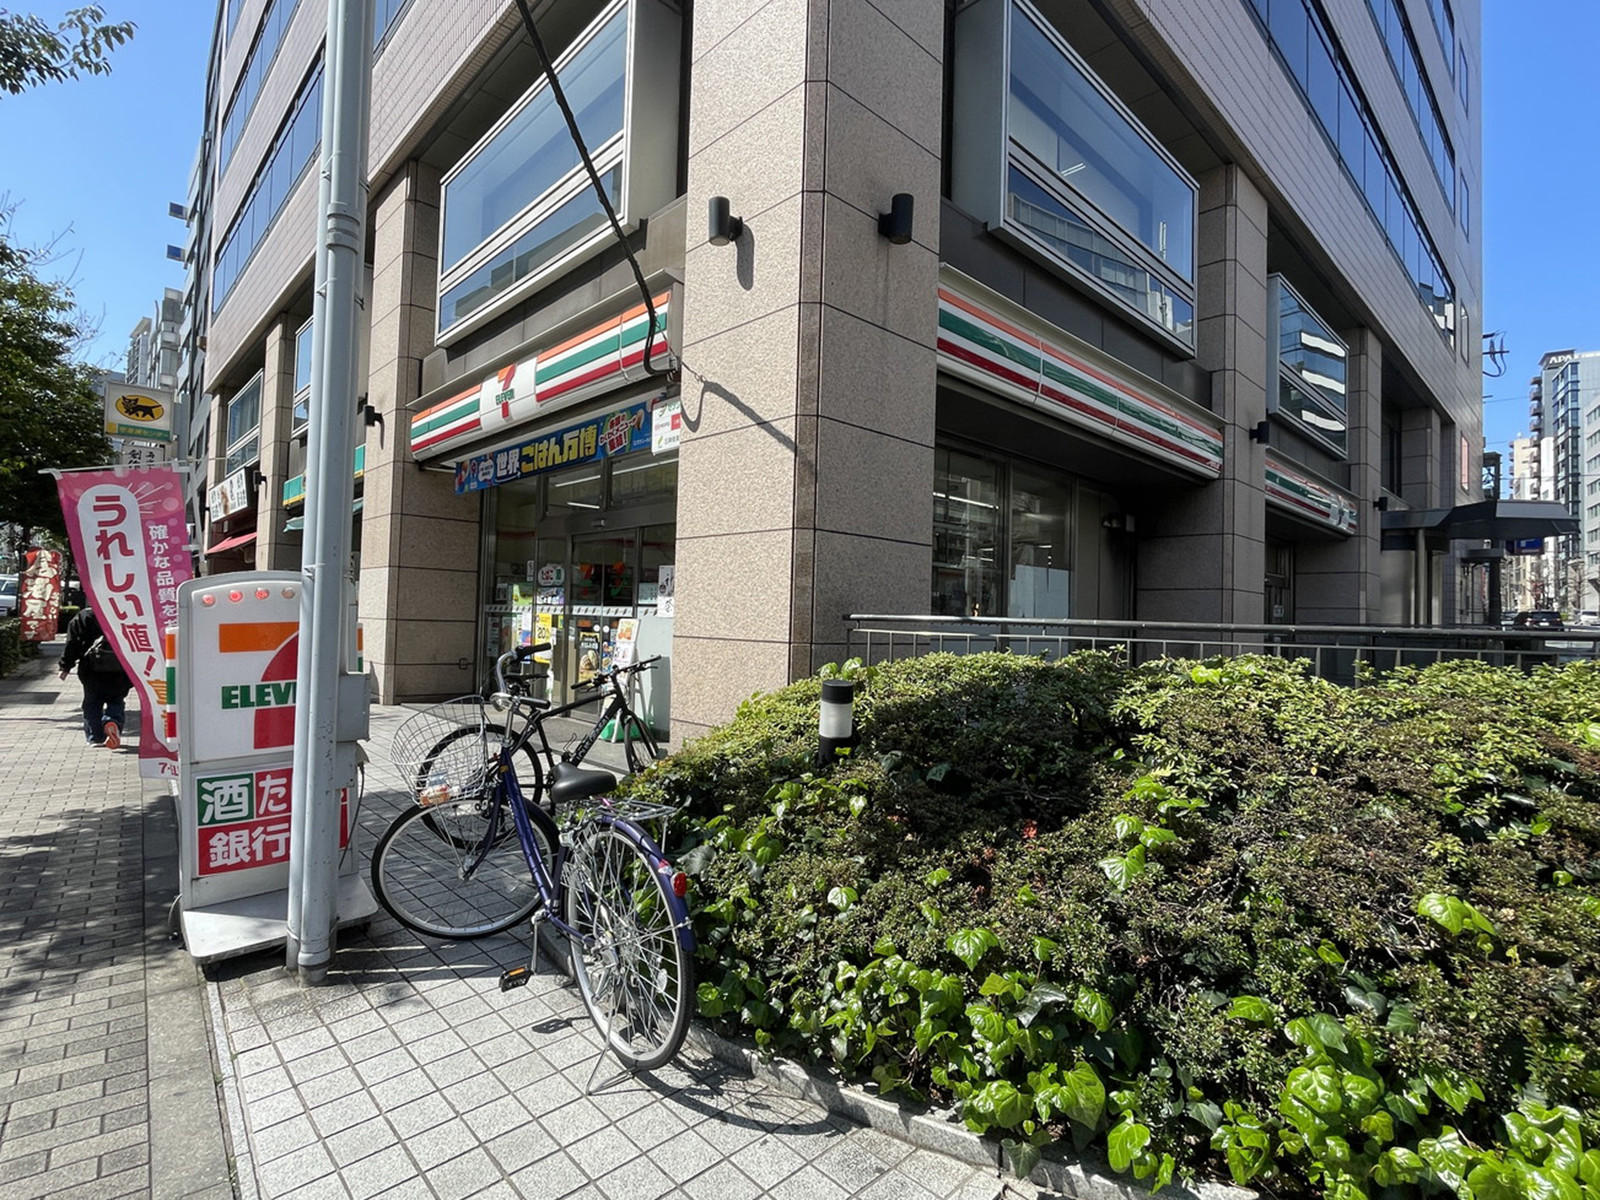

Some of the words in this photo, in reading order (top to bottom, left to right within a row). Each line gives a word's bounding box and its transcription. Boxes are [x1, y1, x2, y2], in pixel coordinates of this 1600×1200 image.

[92, 495, 157, 677] うれしい値!
[221, 681, 298, 710] ELEV
[201, 778, 251, 824] 酒
[209, 822, 290, 868] 銀行
